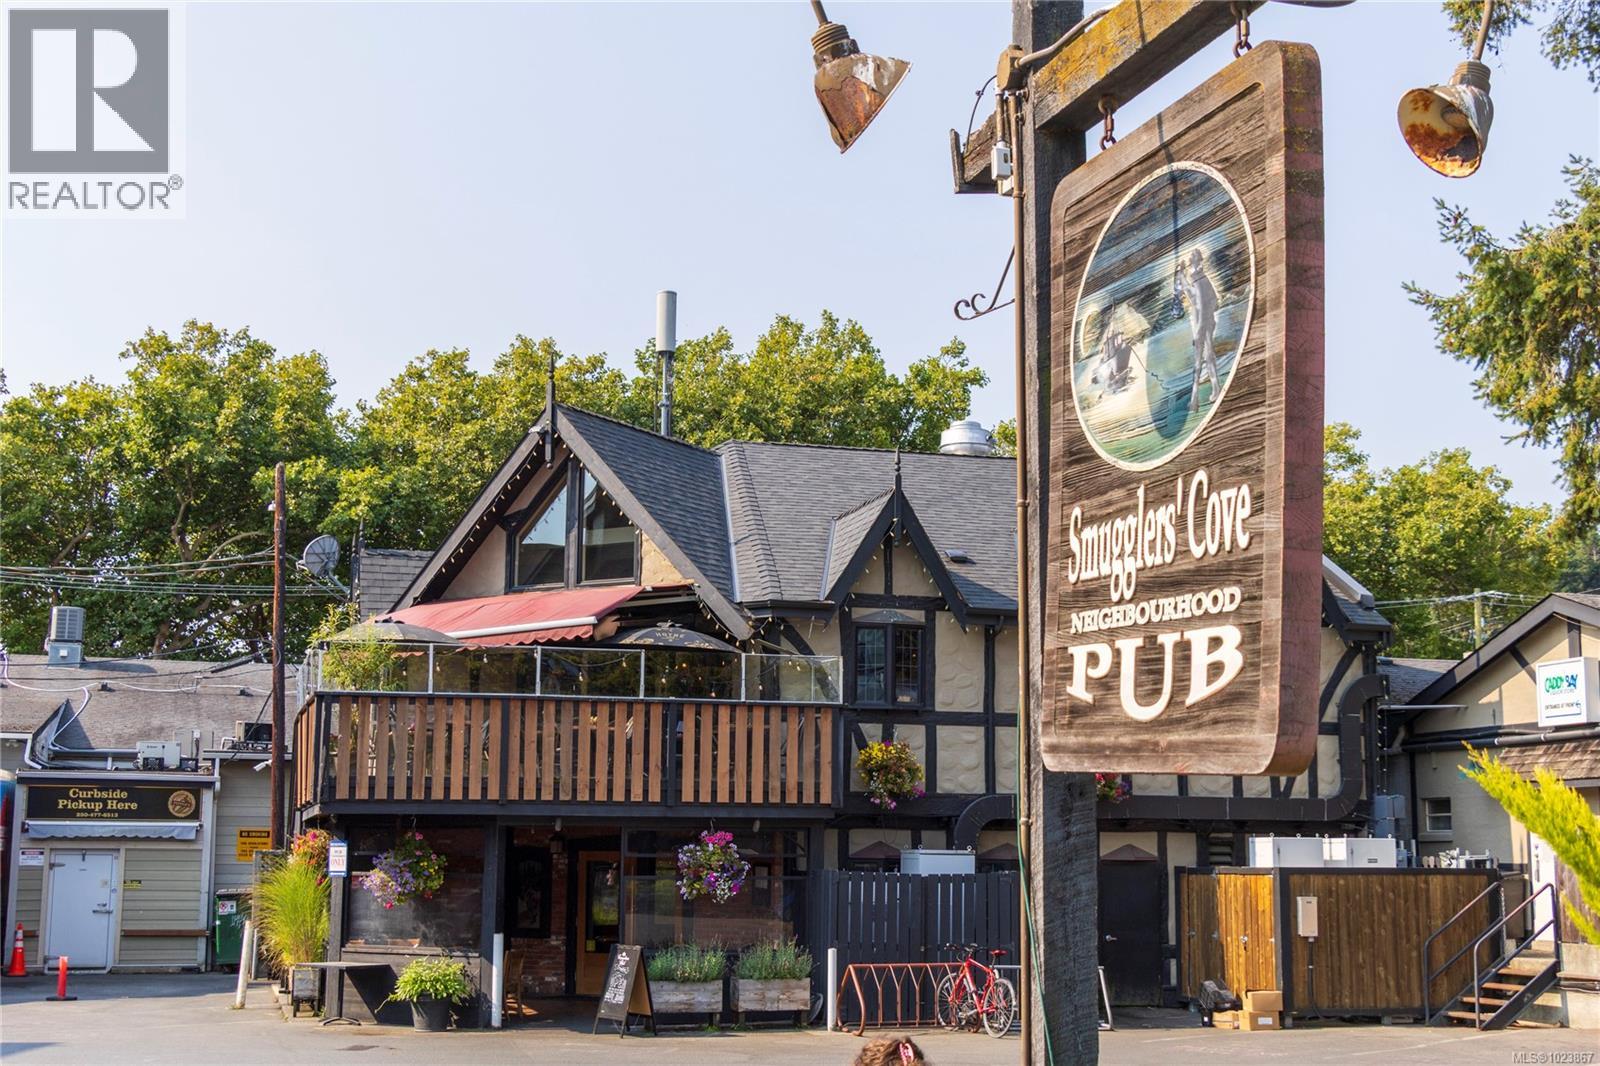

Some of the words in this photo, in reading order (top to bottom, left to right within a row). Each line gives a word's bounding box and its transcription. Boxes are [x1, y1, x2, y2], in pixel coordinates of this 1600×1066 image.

[1067, 476, 1183, 602] Smugglers'
[1187, 469, 1251, 559] Cove
[1070, 586, 1242, 634] NEIGHBOURHOOD
[1066, 624, 1244, 722] PUB
[57, 799, 103, 812] Pickup
[106, 800, 138, 810] Here
[69, 788, 128, 799] Curbside
